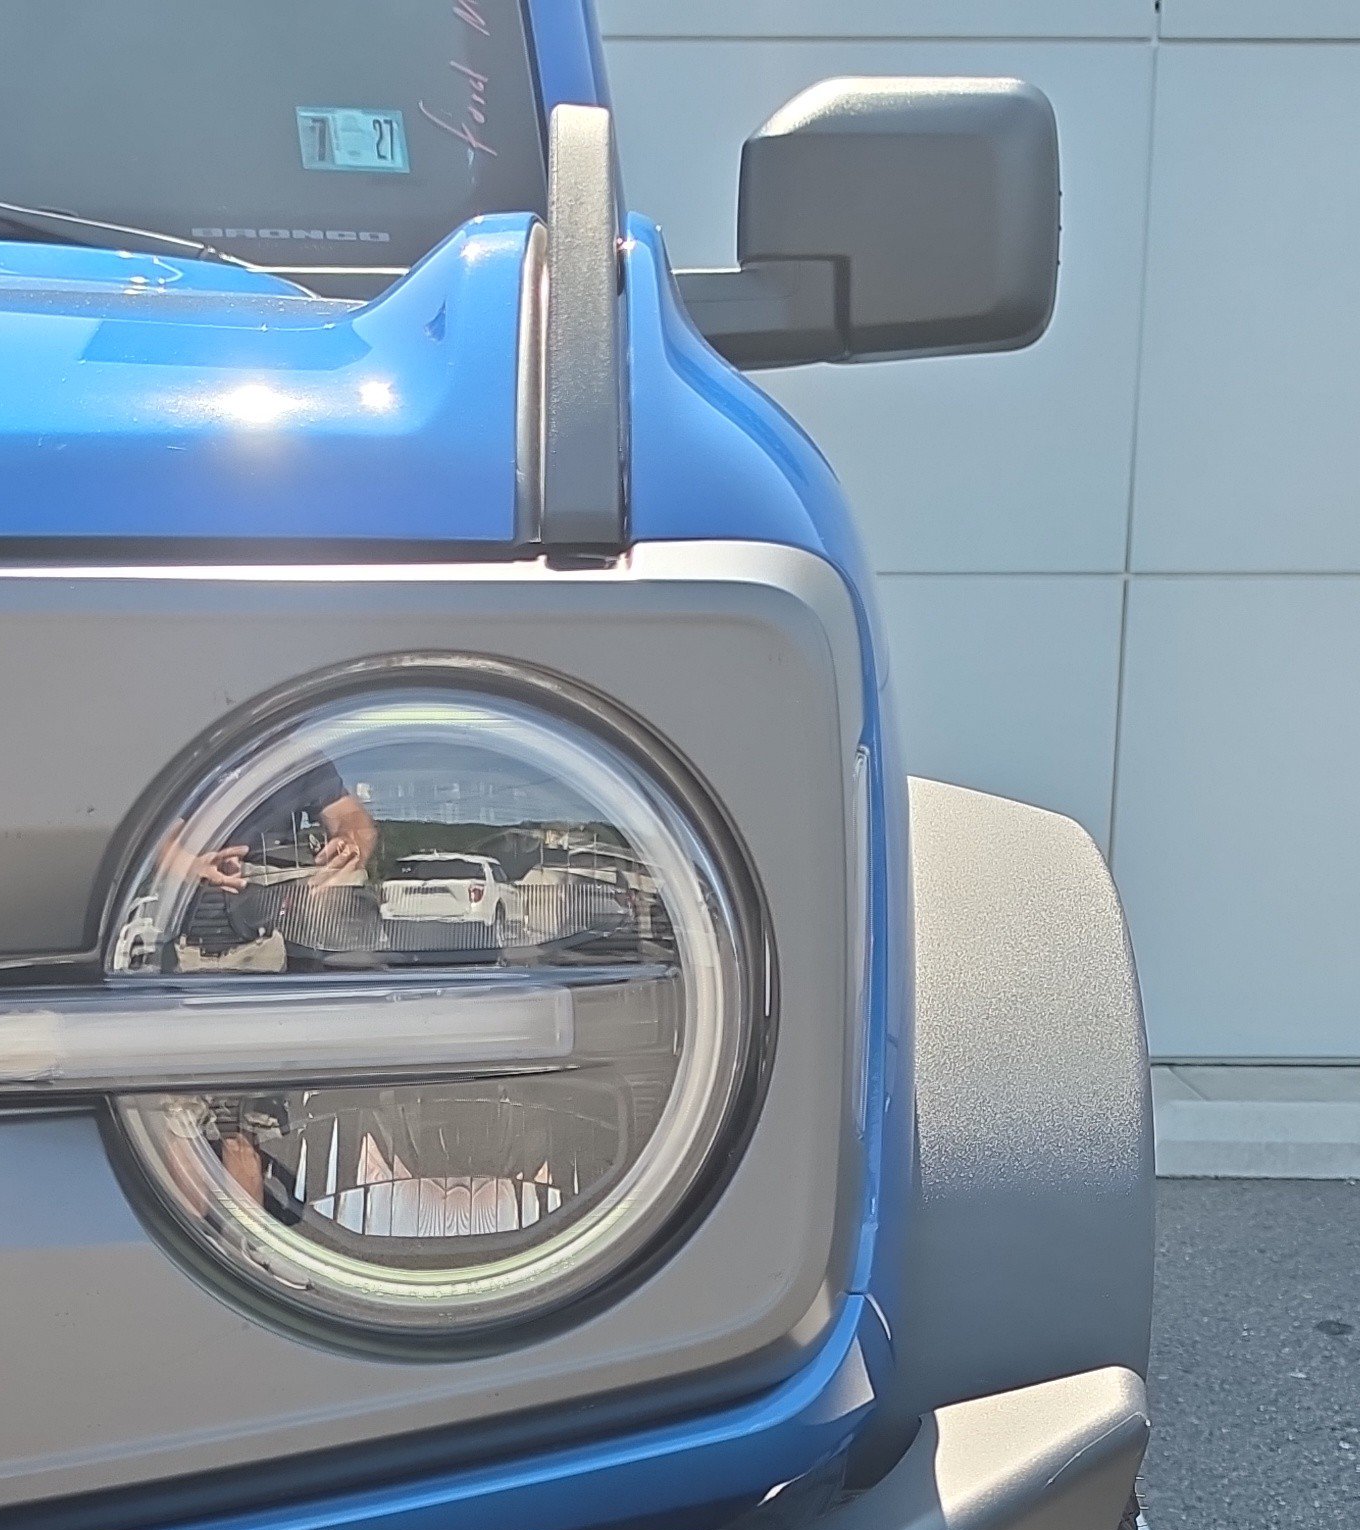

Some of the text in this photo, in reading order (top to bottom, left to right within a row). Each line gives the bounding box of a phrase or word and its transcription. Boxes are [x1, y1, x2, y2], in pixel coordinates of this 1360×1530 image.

[311, 117, 395, 161] 7 27
[191, 227, 390, 242] BRONCO
